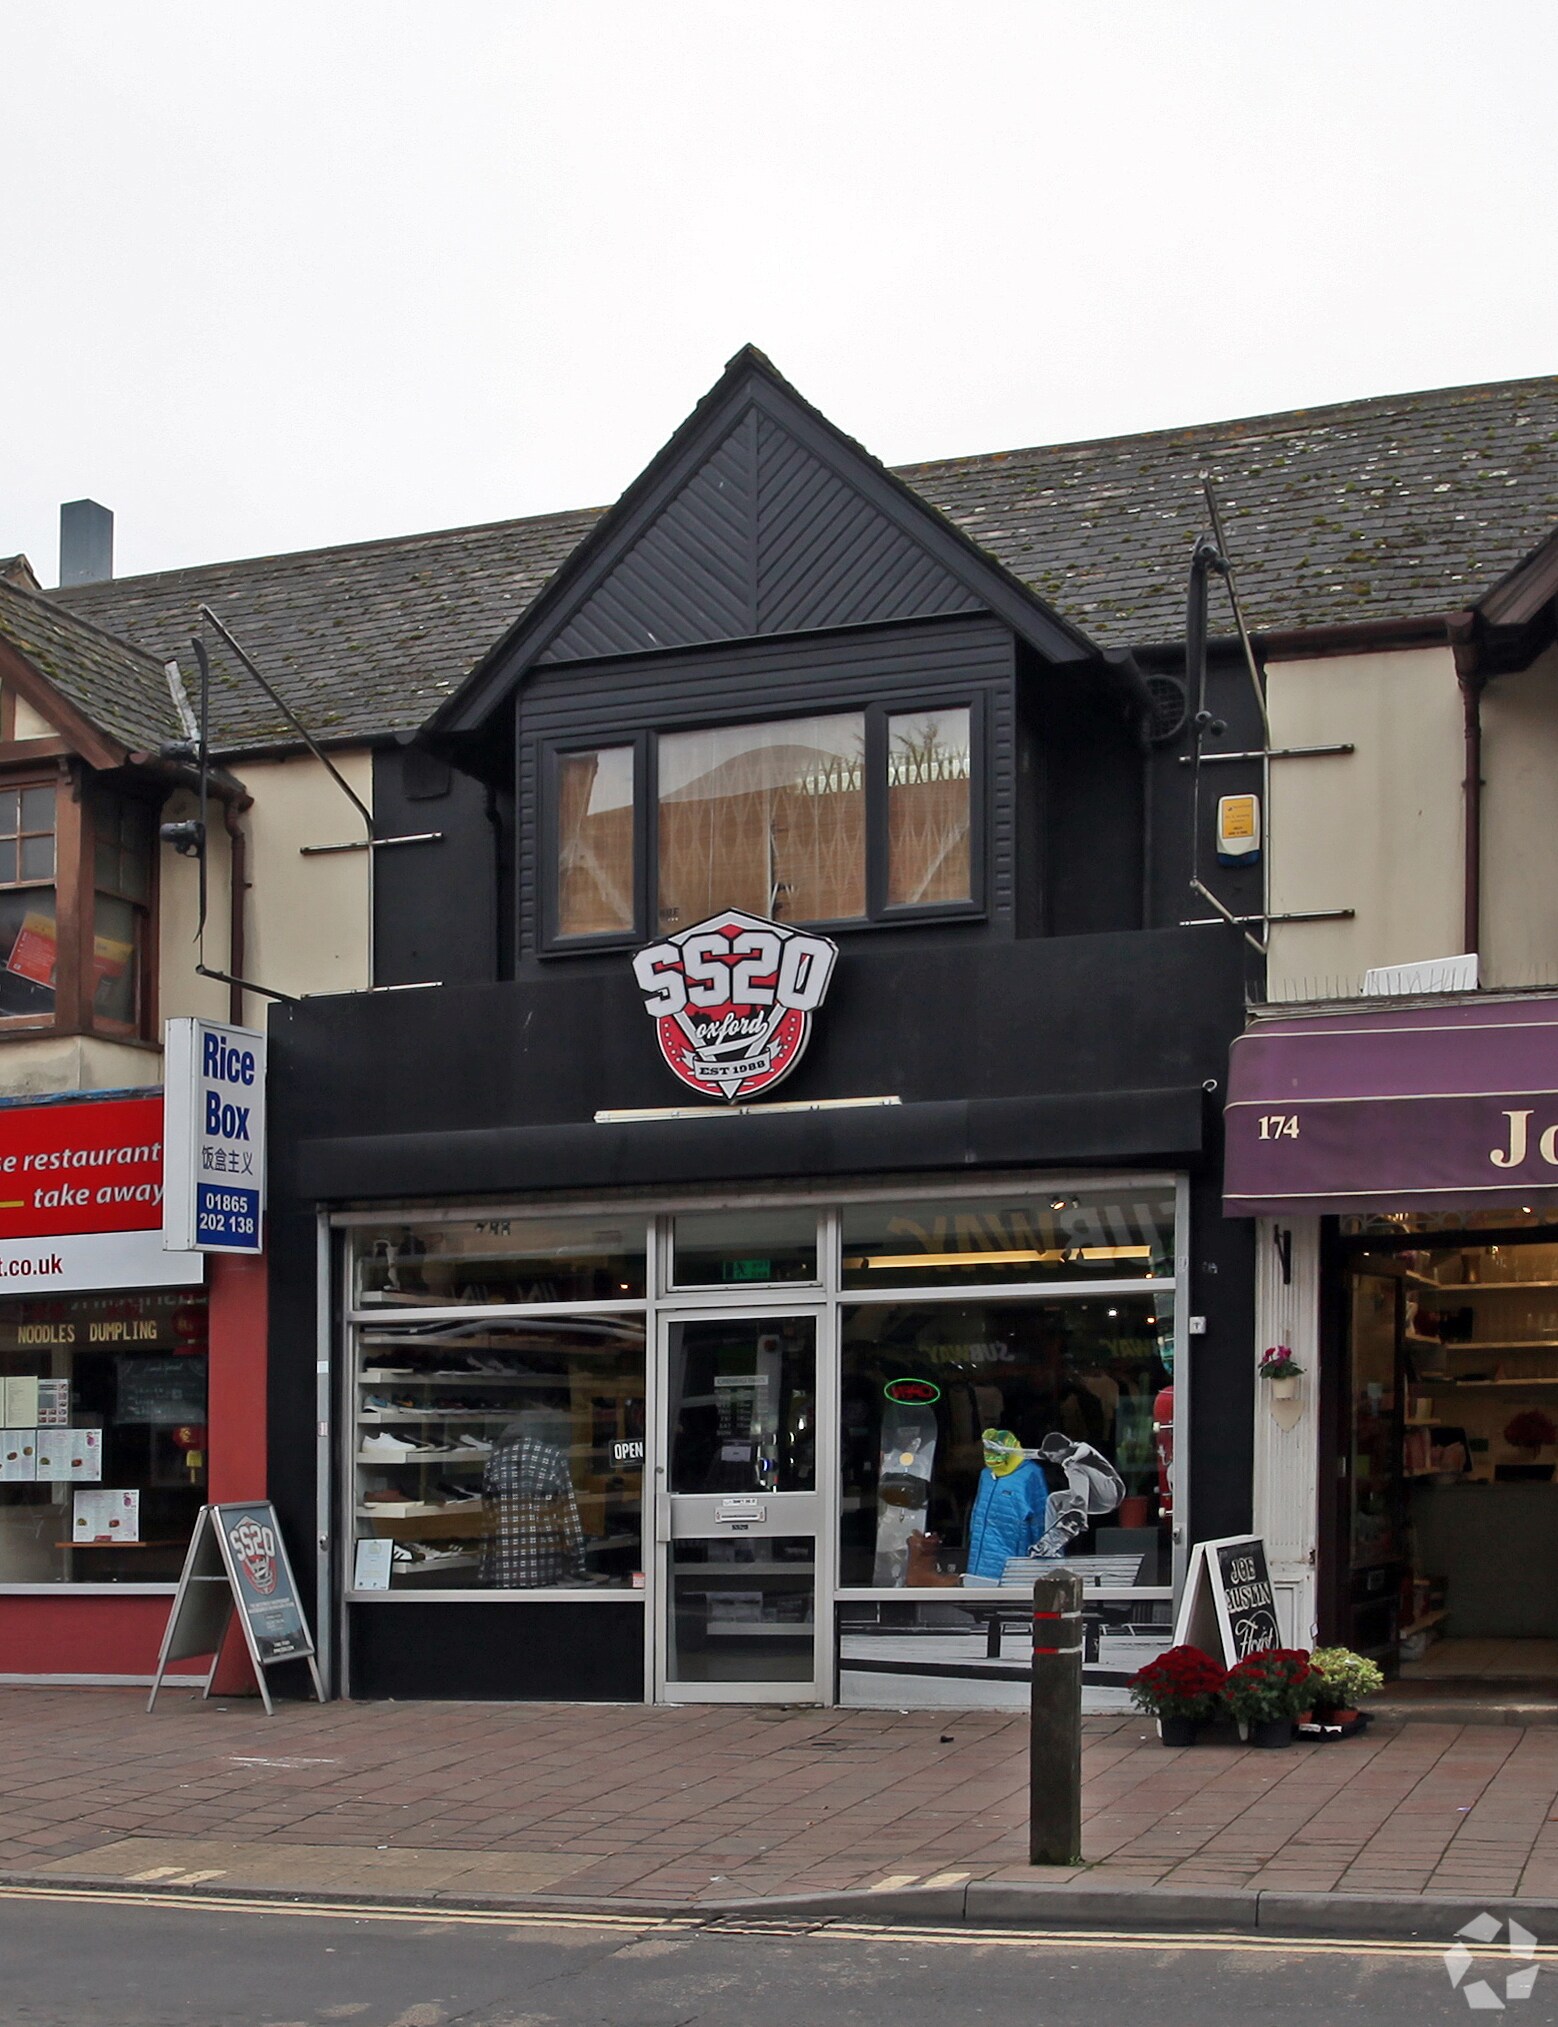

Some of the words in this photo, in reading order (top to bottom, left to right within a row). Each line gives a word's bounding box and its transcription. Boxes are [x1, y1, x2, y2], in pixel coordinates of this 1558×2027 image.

[632, 931, 836, 1018] SS20
[203, 1031, 255, 1086] Rice
[700, 1066, 730, 1076] EST
[205, 1090, 250, 1141] Box
[1257, 1114, 1300, 1140] 174
[23, 1142, 162, 1171] restaurant
[202, 1145, 253, 1176] 饭盒主义
[34, 1183, 90, 1208] take
[96, 1183, 164, 1206] away
[206, 1192, 248, 1213] 01865
[200, 1212, 225, 1231] 202
[229, 1216, 254, 1234] 138
[0, 1253, 63, 1277] .co.uk
[17, 1324, 76, 1344] NOODLES
[89, 1320, 157, 1342] DUMPLING
[614, 1442, 644, 1459] OPEN
[229, 1524, 276, 1561] SS20
[1230, 1557, 1257, 1584] JOE
